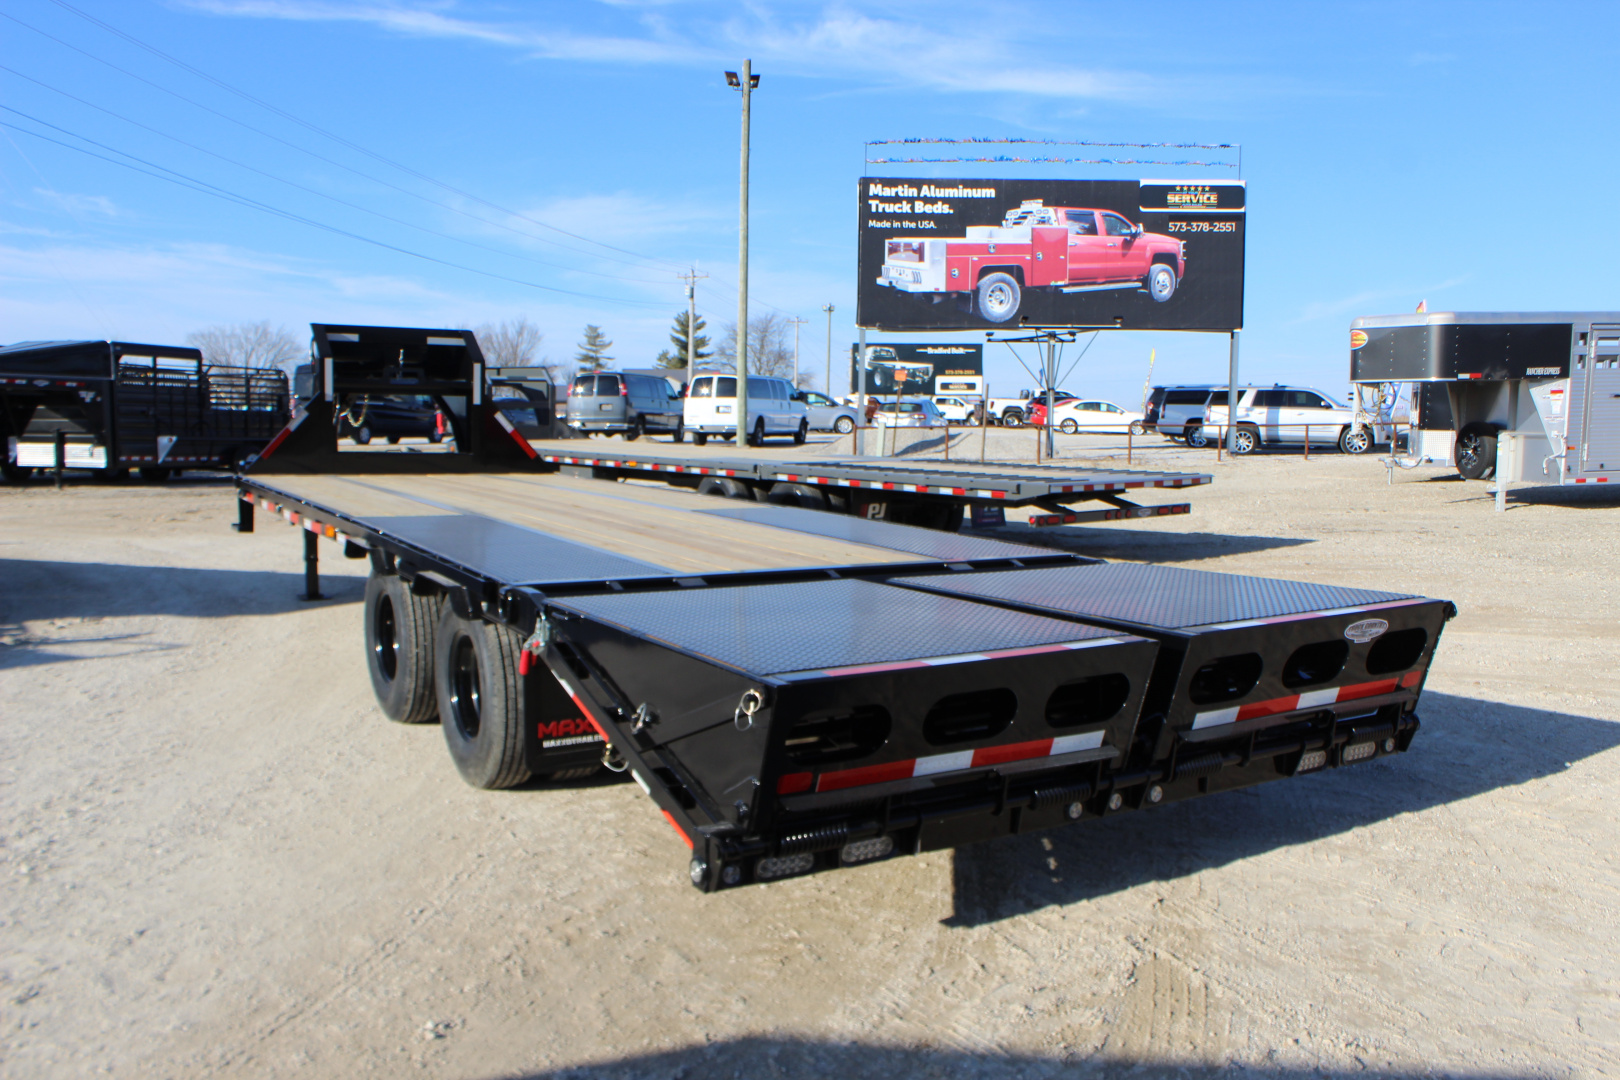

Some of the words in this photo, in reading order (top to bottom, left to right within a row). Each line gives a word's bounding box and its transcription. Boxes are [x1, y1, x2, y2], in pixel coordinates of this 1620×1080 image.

[869, 183, 918, 198] Martin
[920, 184, 996, 199] Aluminum
[1167, 192, 1218, 203] SERVICE
[868, 199, 912, 213] Truck
[914, 200, 954, 215] Beds.
[868, 219, 892, 229] Made
[893, 219, 900, 229] in
[902, 219, 916, 229] the
[918, 220, 938, 229] USA.
[1168, 221, 1236, 232] 573-378-2551
[867, 503, 887, 519] PJ
